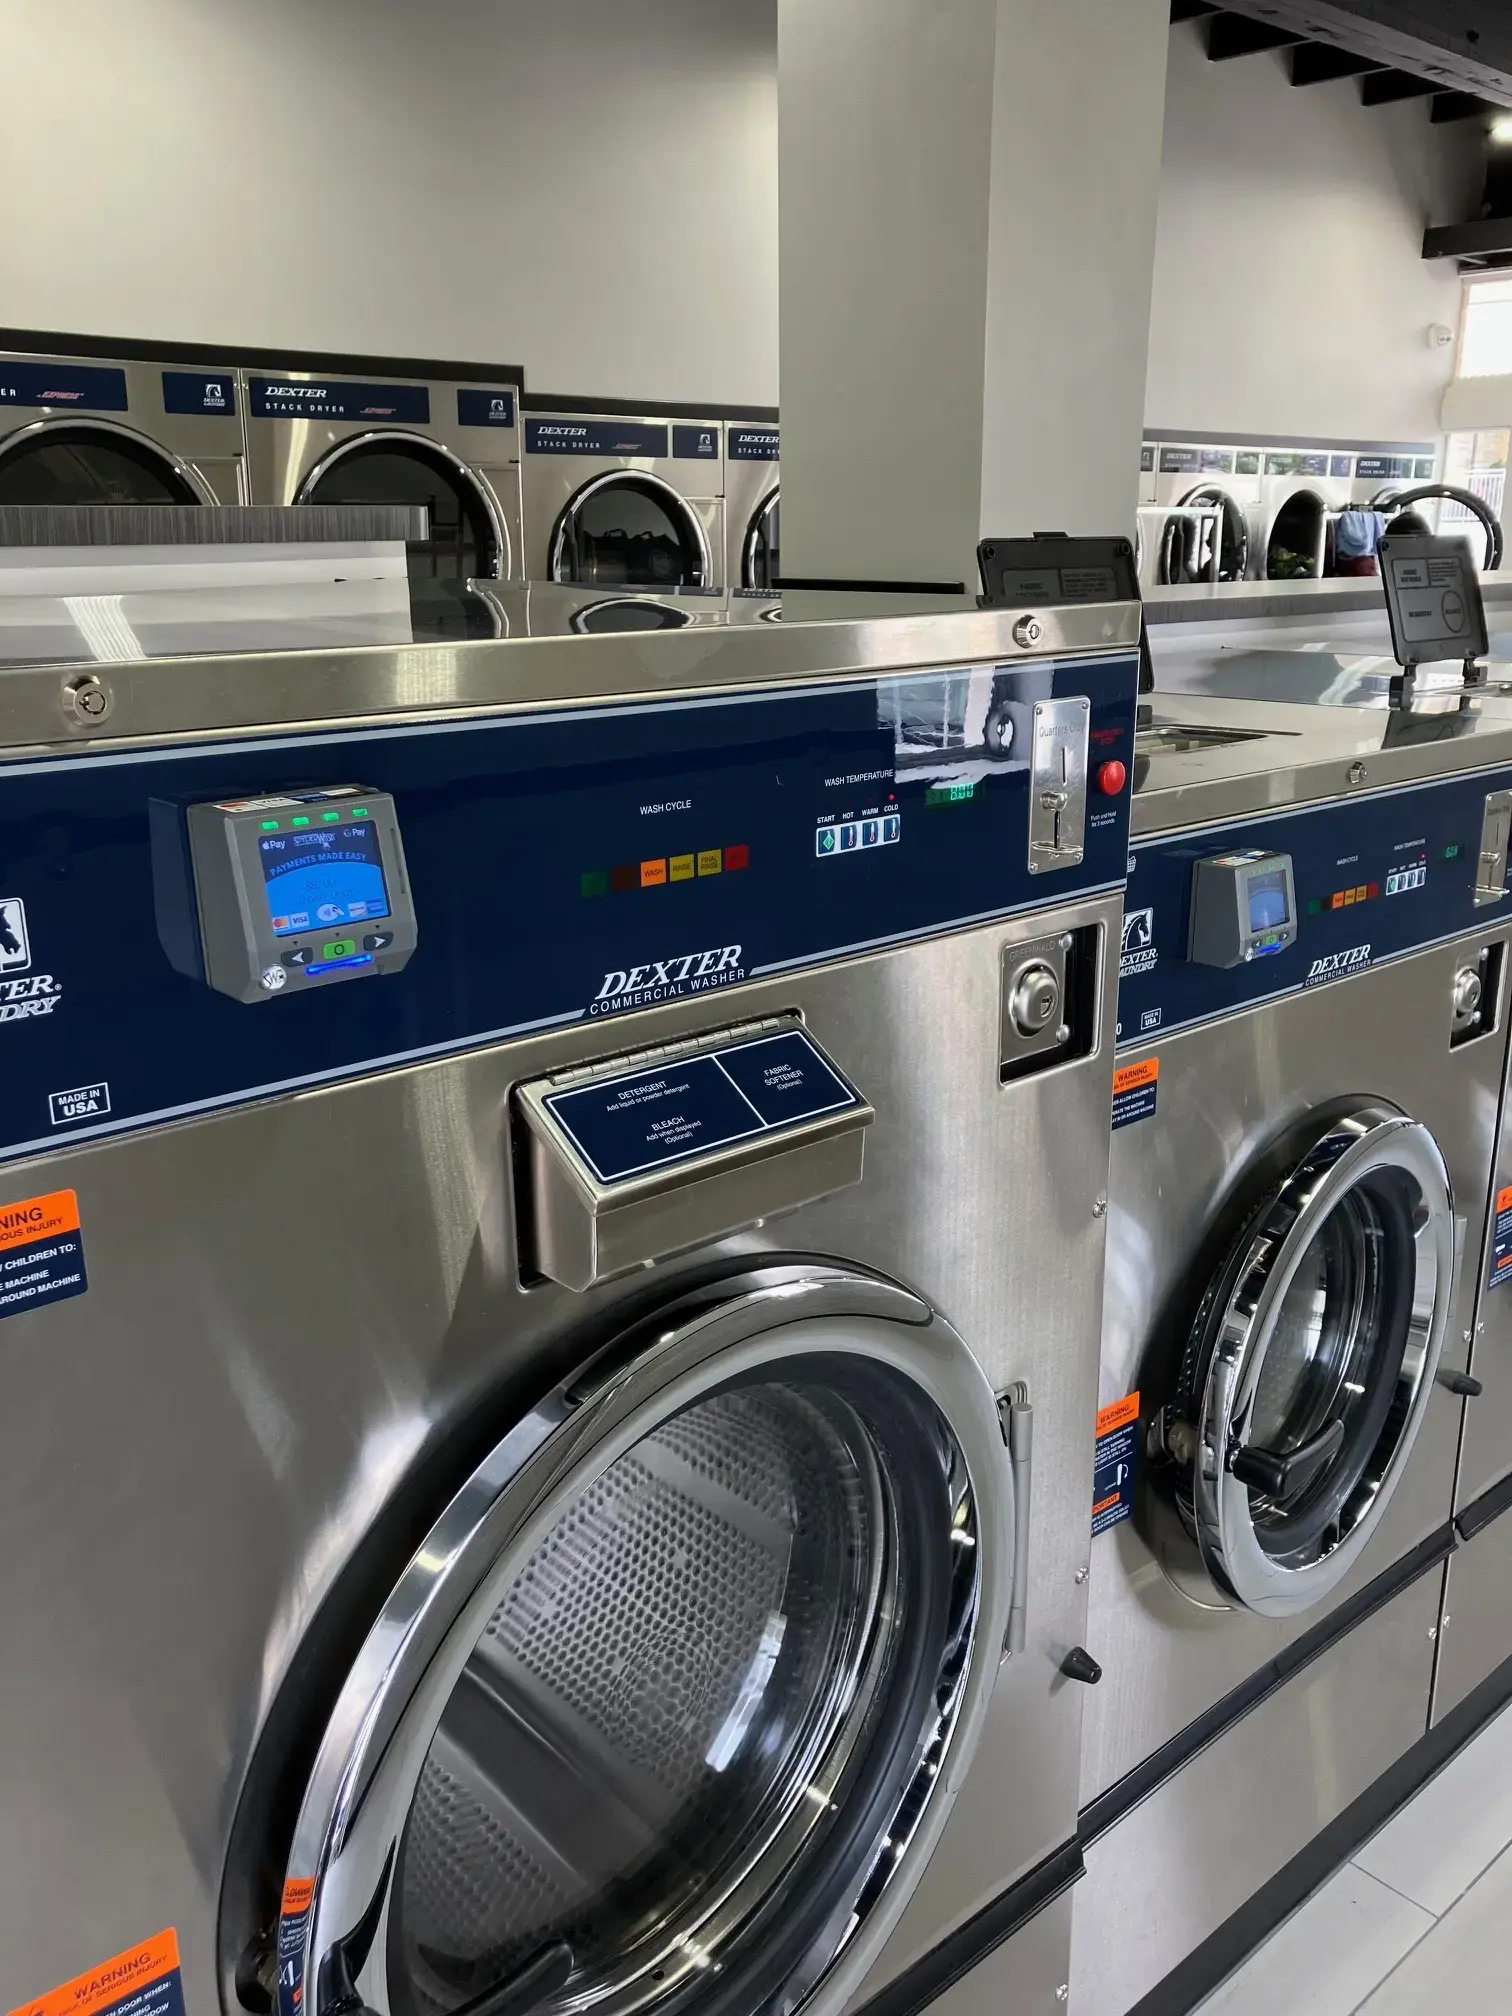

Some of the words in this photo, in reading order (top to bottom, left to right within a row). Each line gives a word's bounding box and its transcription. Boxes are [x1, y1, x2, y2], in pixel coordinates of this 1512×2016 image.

[265, 387, 327, 398] DEXTER
[265, 402, 302, 411] STACK
[310, 404, 345, 413] DRYER
[537, 426, 587, 436] DEXTER
[537, 440, 567, 448] STACK
[572, 441, 601, 449] DRYER
[1039, 725, 1068, 738] Quarters
[825, 776, 845, 787] WASH
[846, 769, 894, 784] TEMPERATURE
[640, 803, 664, 815] WASH
[665, 799, 692, 812] CYCLE
[842, 811, 855, 820] HOT
[861, 807, 879, 817] WARM
[883, 803, 899, 813] COLD
[817, 814, 835, 824] START
[352, 828, 366, 838] Pay
[270, 840, 286, 850] Pay
[270, 855, 316, 876] PAYMENTS
[318, 852, 343, 861] MADE
[346, 853, 367, 861] EASY
[672, 863, 691, 872] RINSE
[700, 855, 717, 864] FINAL
[700, 862, 719, 870] RINSE
[644, 868, 664, 877] WASH
[292, 916, 308, 924] VISA
[1119, 948, 1157, 967] EXTER
[1308, 944, 1371, 978] DEXTER
[595, 944, 742, 1000] DEXTER
[1119, 959, 1158, 978] AUNDRY
[1305, 967, 1345, 987] COMMERCIAL
[1347, 959, 1371, 973] WASHER
[0, 974, 54, 1001] TER
[590, 984, 685, 1015] COMMERCIAL
[691, 968, 745, 990] WASHER
[1145, 1016, 1157, 1026] USA
[763, 1064, 791, 1077] FABRIC
[764, 1069, 804, 1086] SOFTENER
[1118, 1065, 1148, 1082] WARNING
[618, 1080, 667, 1100] DETERGENT
[776, 1078, 803, 1091] (Optional)
[58, 1091, 88, 1106] MADE
[89, 1089, 100, 1099] IN
[606, 1103, 619, 1112] Add
[619, 1099, 636, 1108] liquid
[642, 1091, 663, 1102] powder
[663, 1083, 691, 1095] detergent
[63, 1100, 99, 1117] USA
[646, 1133, 659, 1142] Add
[659, 1129, 675, 1138] when
[675, 1120, 702, 1133] displayed
[651, 1116, 686, 1131] BLEACH
[664, 1131, 694, 1145] (Optional)
[0, 1207, 43, 1230] NING
[26, 1217, 63, 1234] INJURY
[5, 1247, 58, 1270] CHILDREN
[58, 1243, 77, 1254] TO:
[5, 1269, 50, 1289] MACHINE
[37, 1273, 81, 1294] MACHINE
[1100, 1403, 1130, 1424] WARNING
[73, 1952, 151, 2000] WARNING
[81, 1995, 93, 2006] OF
[96, 1974, 135, 1998] SERIOUS
[136, 1954, 168, 1976] INJURY
[117, 1996, 143, 2015] DOOR
[143, 1980, 172, 2000] WHEN:
